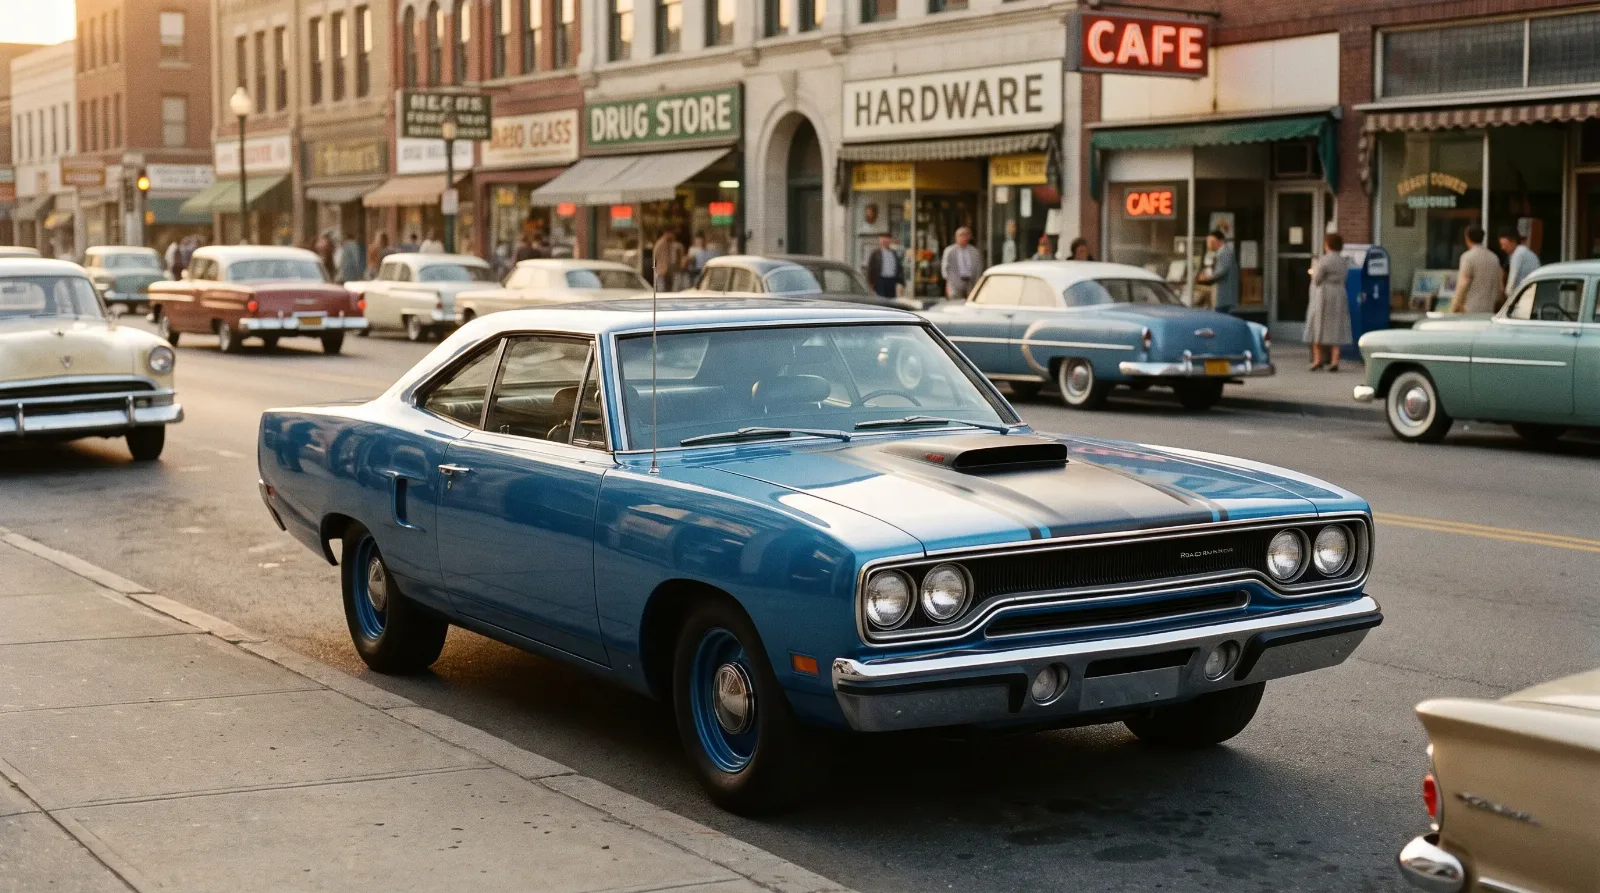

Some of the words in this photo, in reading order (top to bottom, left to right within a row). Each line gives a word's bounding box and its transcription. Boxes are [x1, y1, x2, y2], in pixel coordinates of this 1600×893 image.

[1087, 20, 1204, 69] CAFE
[590, 103, 649, 141] DRUG
[655, 94, 732, 137] STORE
[855, 74, 1043, 126] HARDWARE
[529, 119, 572, 148] GLASS
[1126, 191, 1172, 216] CAFE
